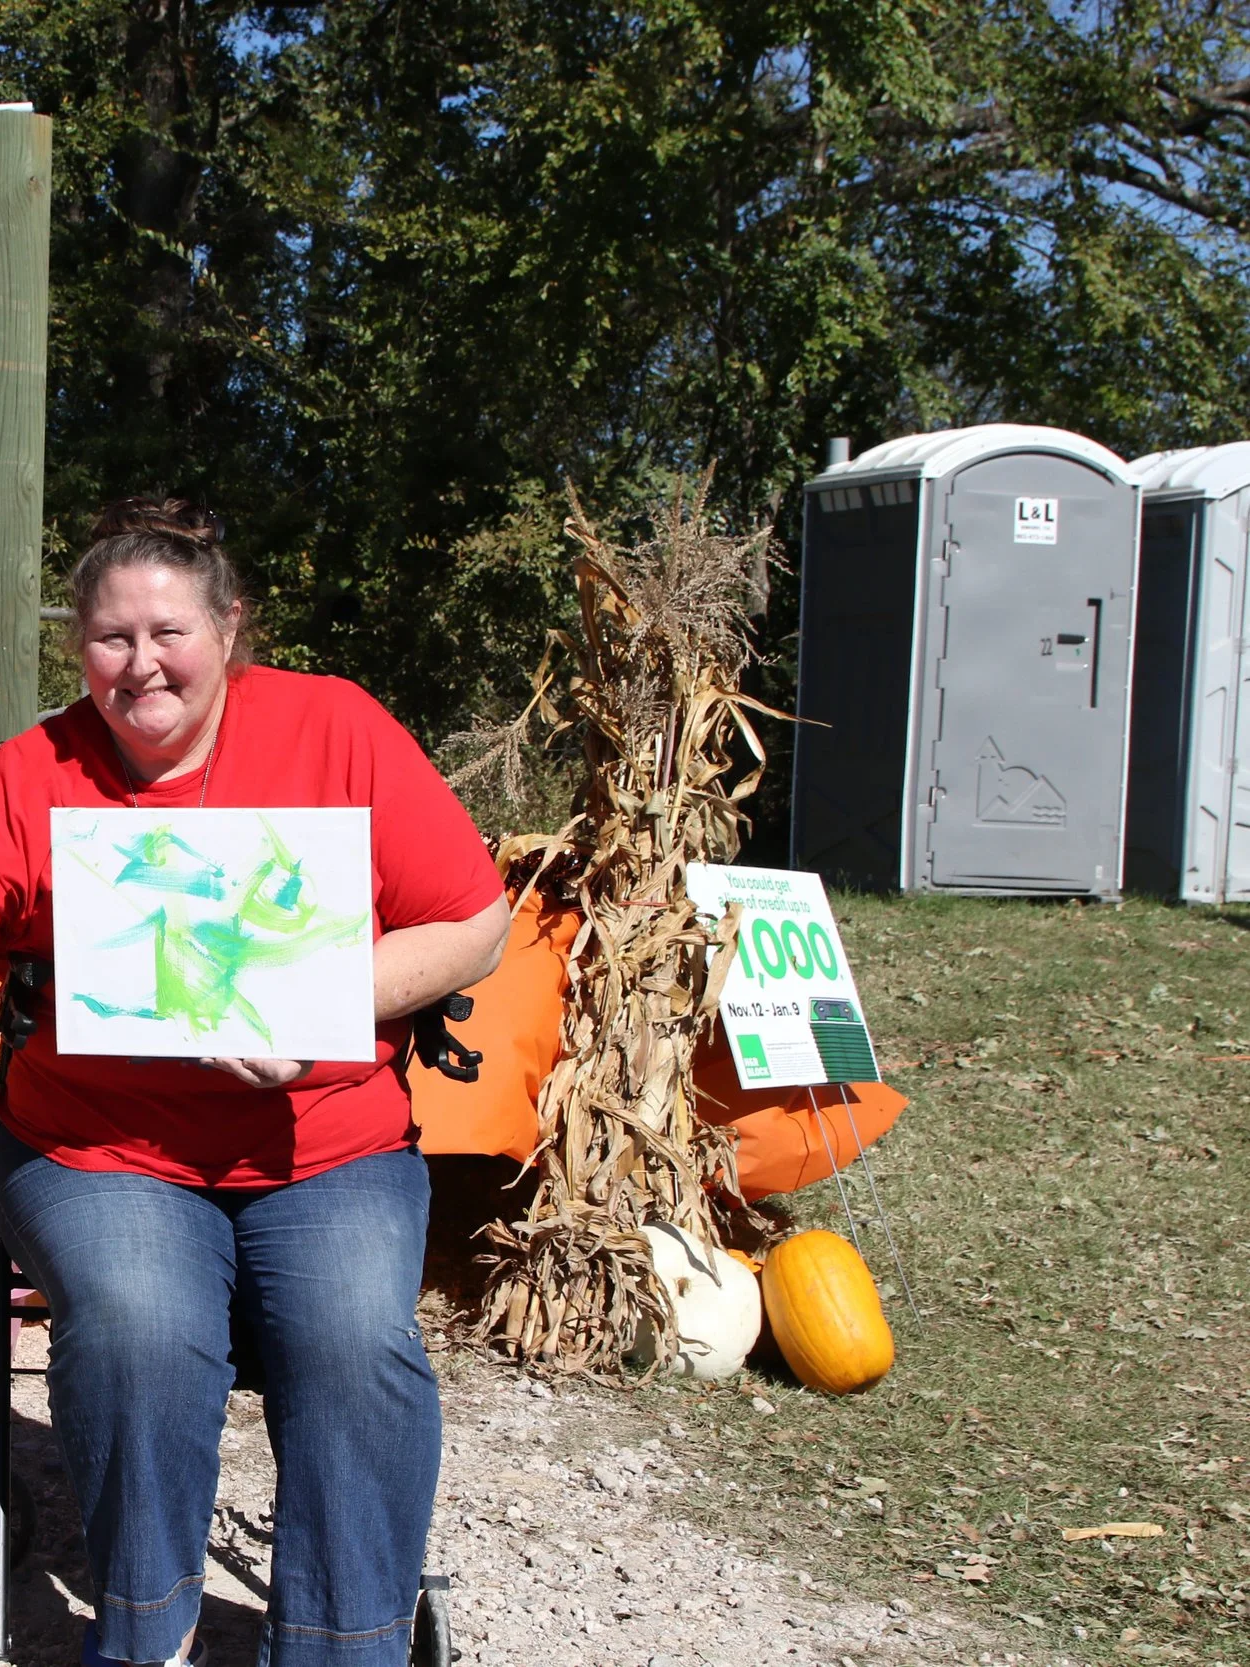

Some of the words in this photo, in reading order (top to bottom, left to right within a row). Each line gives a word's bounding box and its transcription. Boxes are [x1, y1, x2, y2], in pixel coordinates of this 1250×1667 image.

[724, 872, 746, 889] You
[747, 875, 775, 891] could
[775, 879, 792, 895] get
[746, 893, 758, 910] of
[758, 895, 788, 911] credit
[787, 901, 801, 915] up
[799, 900, 811, 913] to
[727, 1002, 752, 1017] Nov.
[751, 1002, 764, 1017] 12
[771, 1002, 793, 1017] Jan.
[792, 1001, 800, 1016] 9
